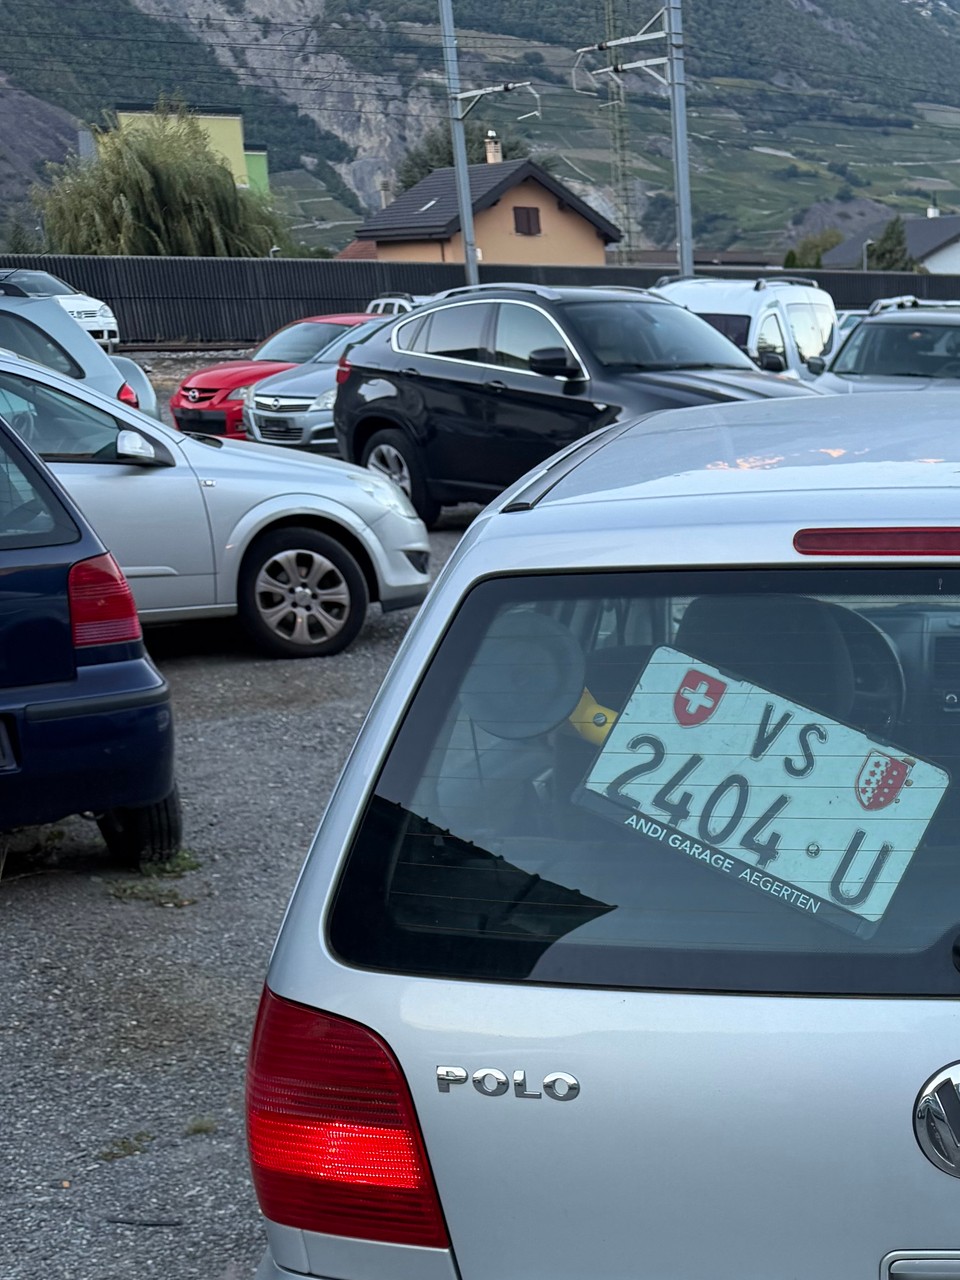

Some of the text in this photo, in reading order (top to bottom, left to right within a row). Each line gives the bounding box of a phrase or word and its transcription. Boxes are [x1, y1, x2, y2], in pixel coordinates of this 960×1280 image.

[750, 702, 827, 778] VS
[605, 733, 792, 868] 2404
[624, 813, 821, 914] ANDI GARAGE AEGERTEN
[436, 1065, 580, 1102] POLO
